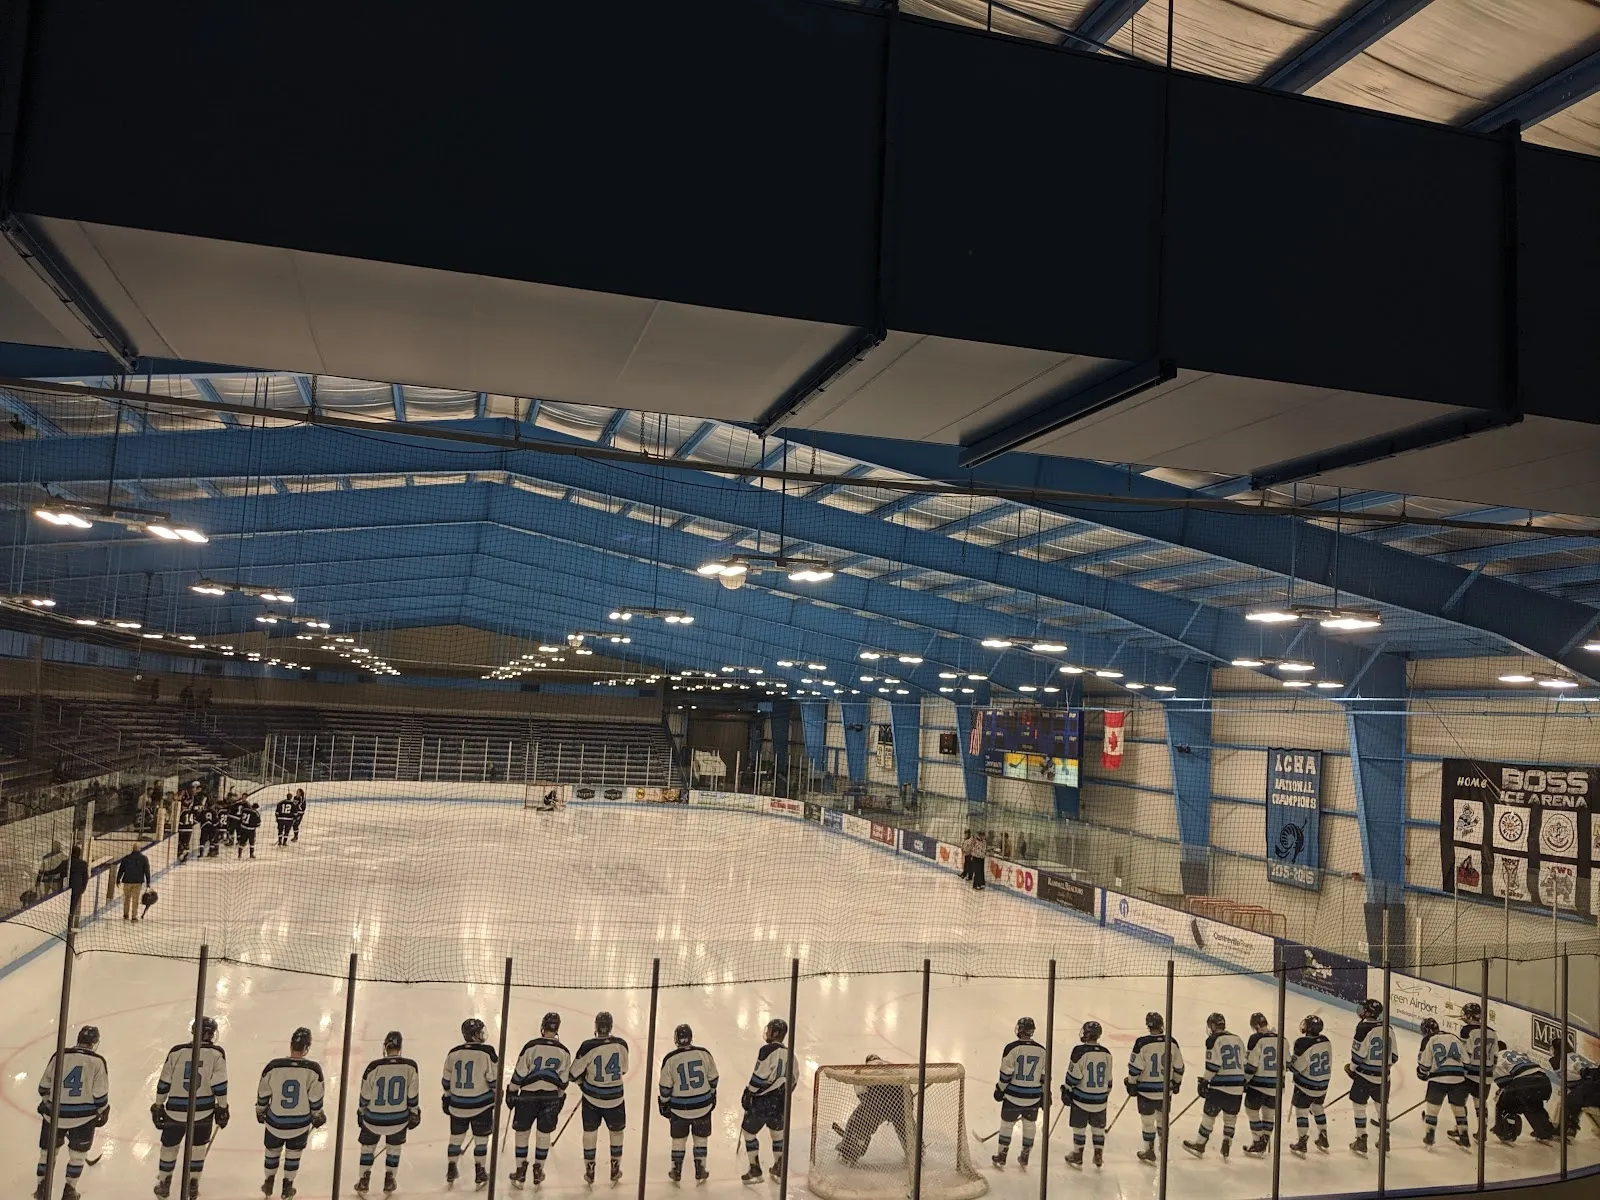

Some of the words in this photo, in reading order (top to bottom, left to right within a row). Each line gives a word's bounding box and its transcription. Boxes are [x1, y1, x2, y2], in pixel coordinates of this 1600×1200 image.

[1274, 778, 1315, 793] NATIONAL
[1501, 767, 1589, 795] BOSS
[280, 803, 292, 814] 12
[1271, 793, 1317, 809] CHAMPIONS
[1500, 791, 1525, 804] ICE
[1528, 794, 1588, 808] ARENA
[1409, 997, 1439, 1015] Airport
[592, 1052, 621, 1082] 14
[1220, 1044, 1242, 1069] 20
[1309, 1050, 1331, 1076] 22
[1432, 1042, 1461, 1067] 24
[63, 1065, 83, 1097] 4
[183, 1060, 204, 1092] 5
[454, 1060, 474, 1090] 11
[676, 1060, 705, 1091] 15
[1015, 1055, 1040, 1081] 17
[1086, 1061, 1107, 1088] 18
[281, 1079, 301, 1110] 9
[374, 1075, 406, 1107] 10
